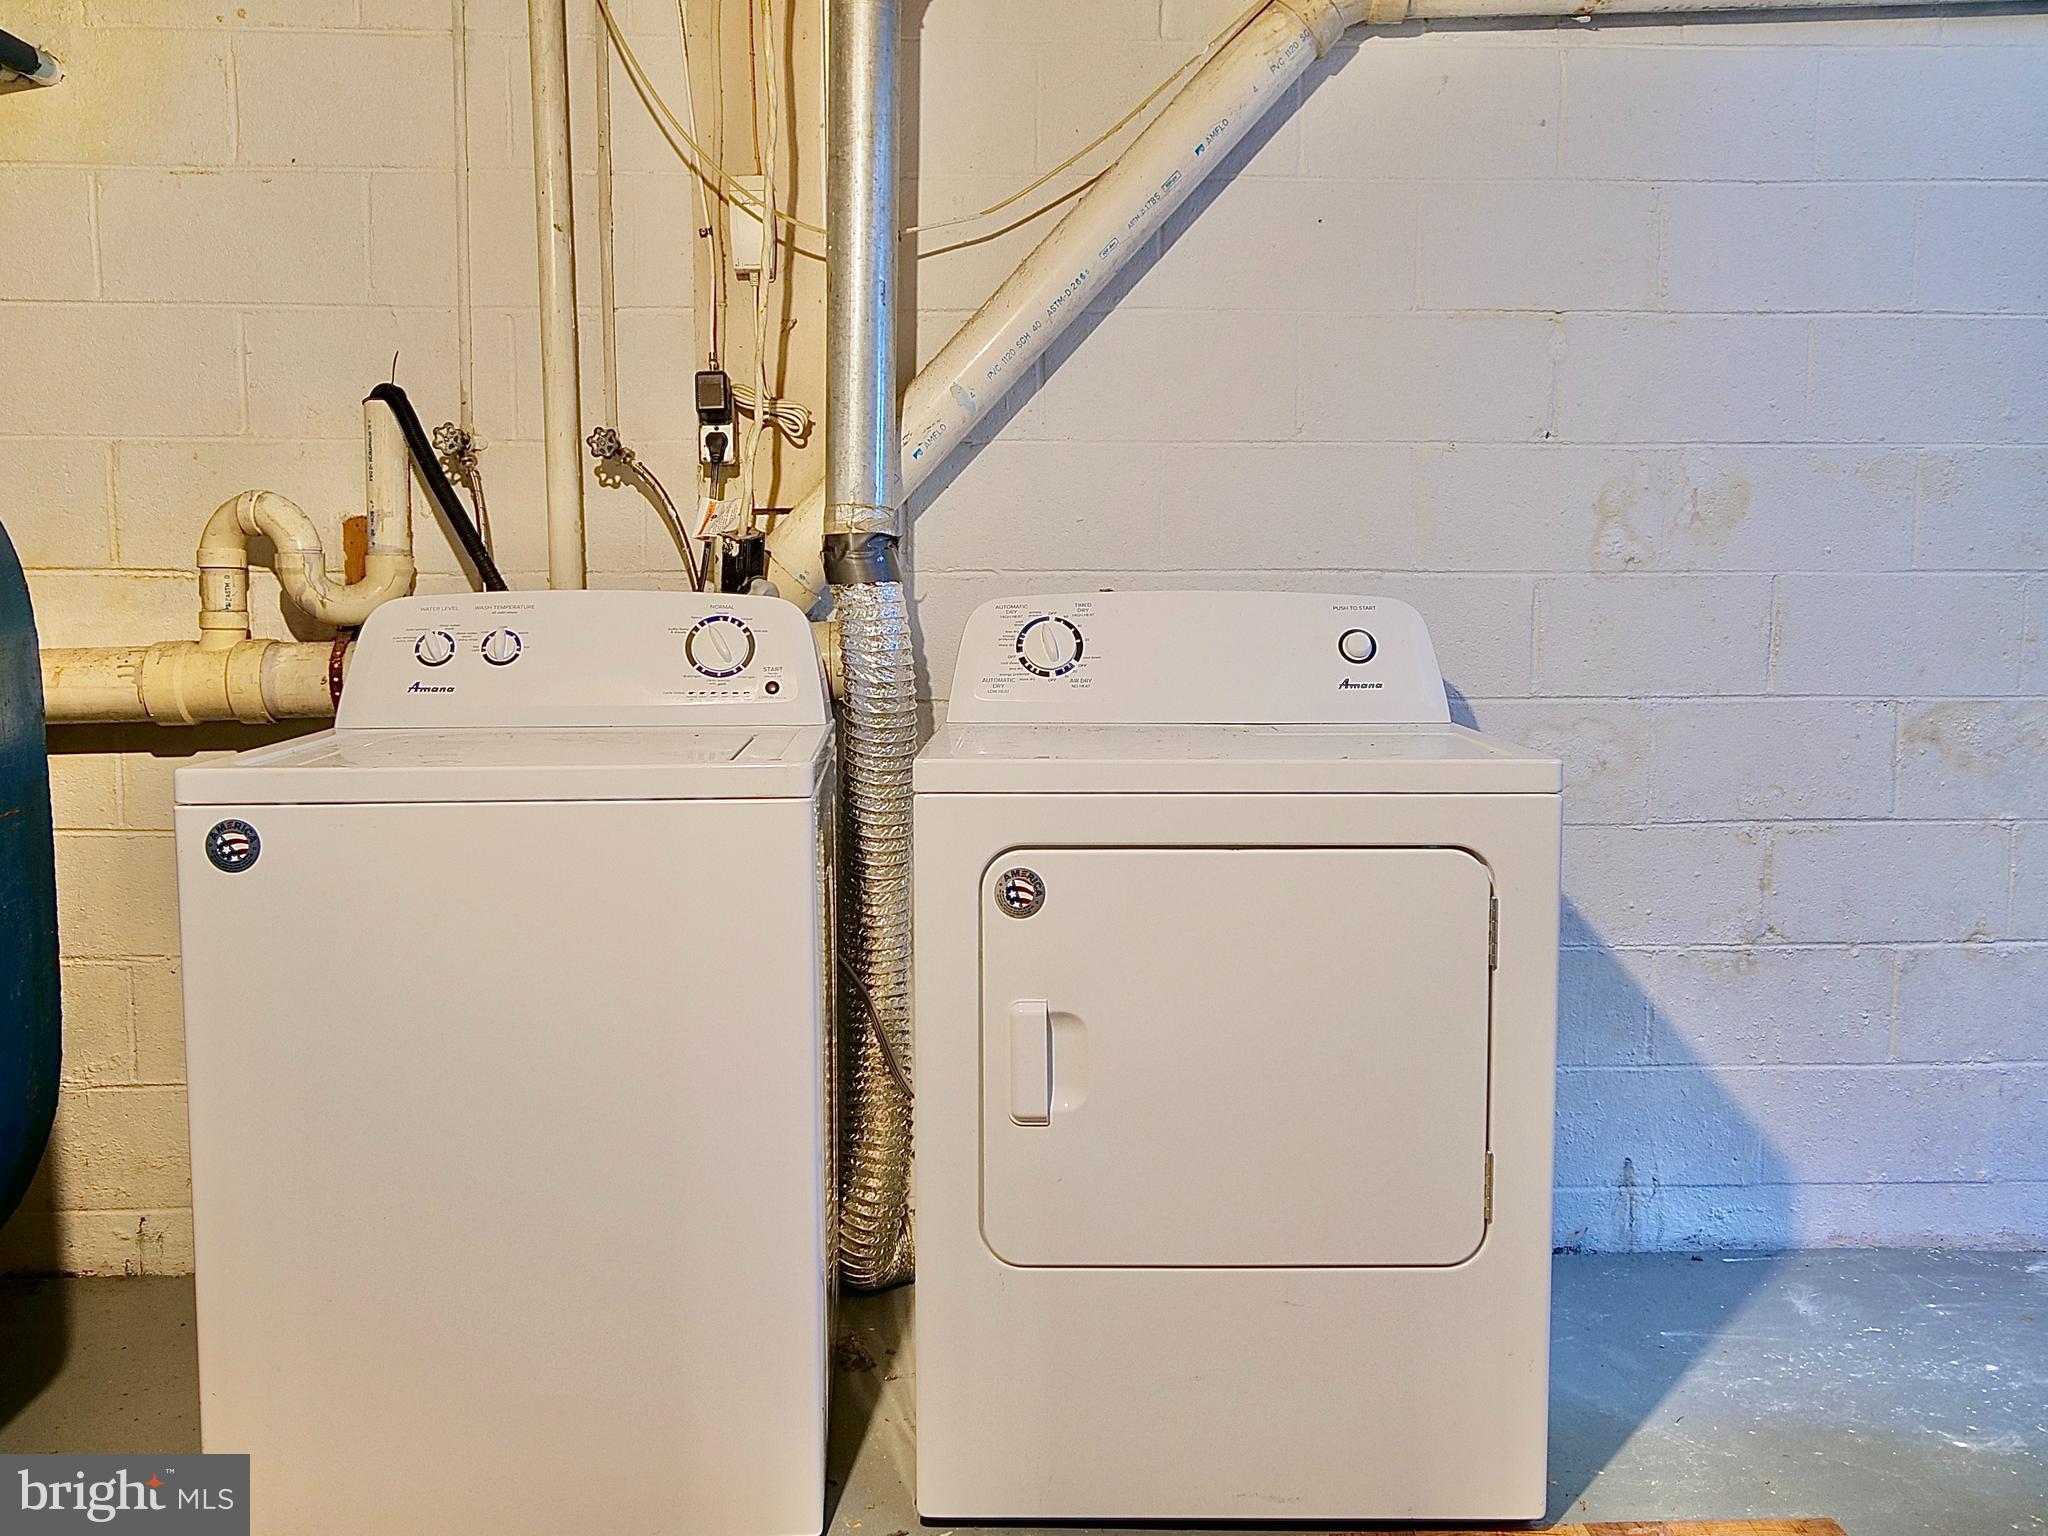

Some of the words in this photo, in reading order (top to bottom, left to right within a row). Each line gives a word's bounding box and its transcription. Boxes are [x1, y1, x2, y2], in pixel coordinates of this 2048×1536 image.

[923, 423, 947, 449] AMFLO
[986, 364, 1002, 380] PVC
[1001, 348, 1017, 365] 1120
[1015, 332, 1031, 349] SCH
[1032, 320, 1042, 332] 40
[1206, 118, 1229, 145] AMFLO
[1270, 58, 1285, 75] PVC
[1285, 41, 1300, 58] 1120
[407, 681, 456, 693] Amana
[1338, 677, 1384, 690] Amana
[209, 820, 258, 843] AMERICA
[1003, 869, 1043, 898] AMERICA
